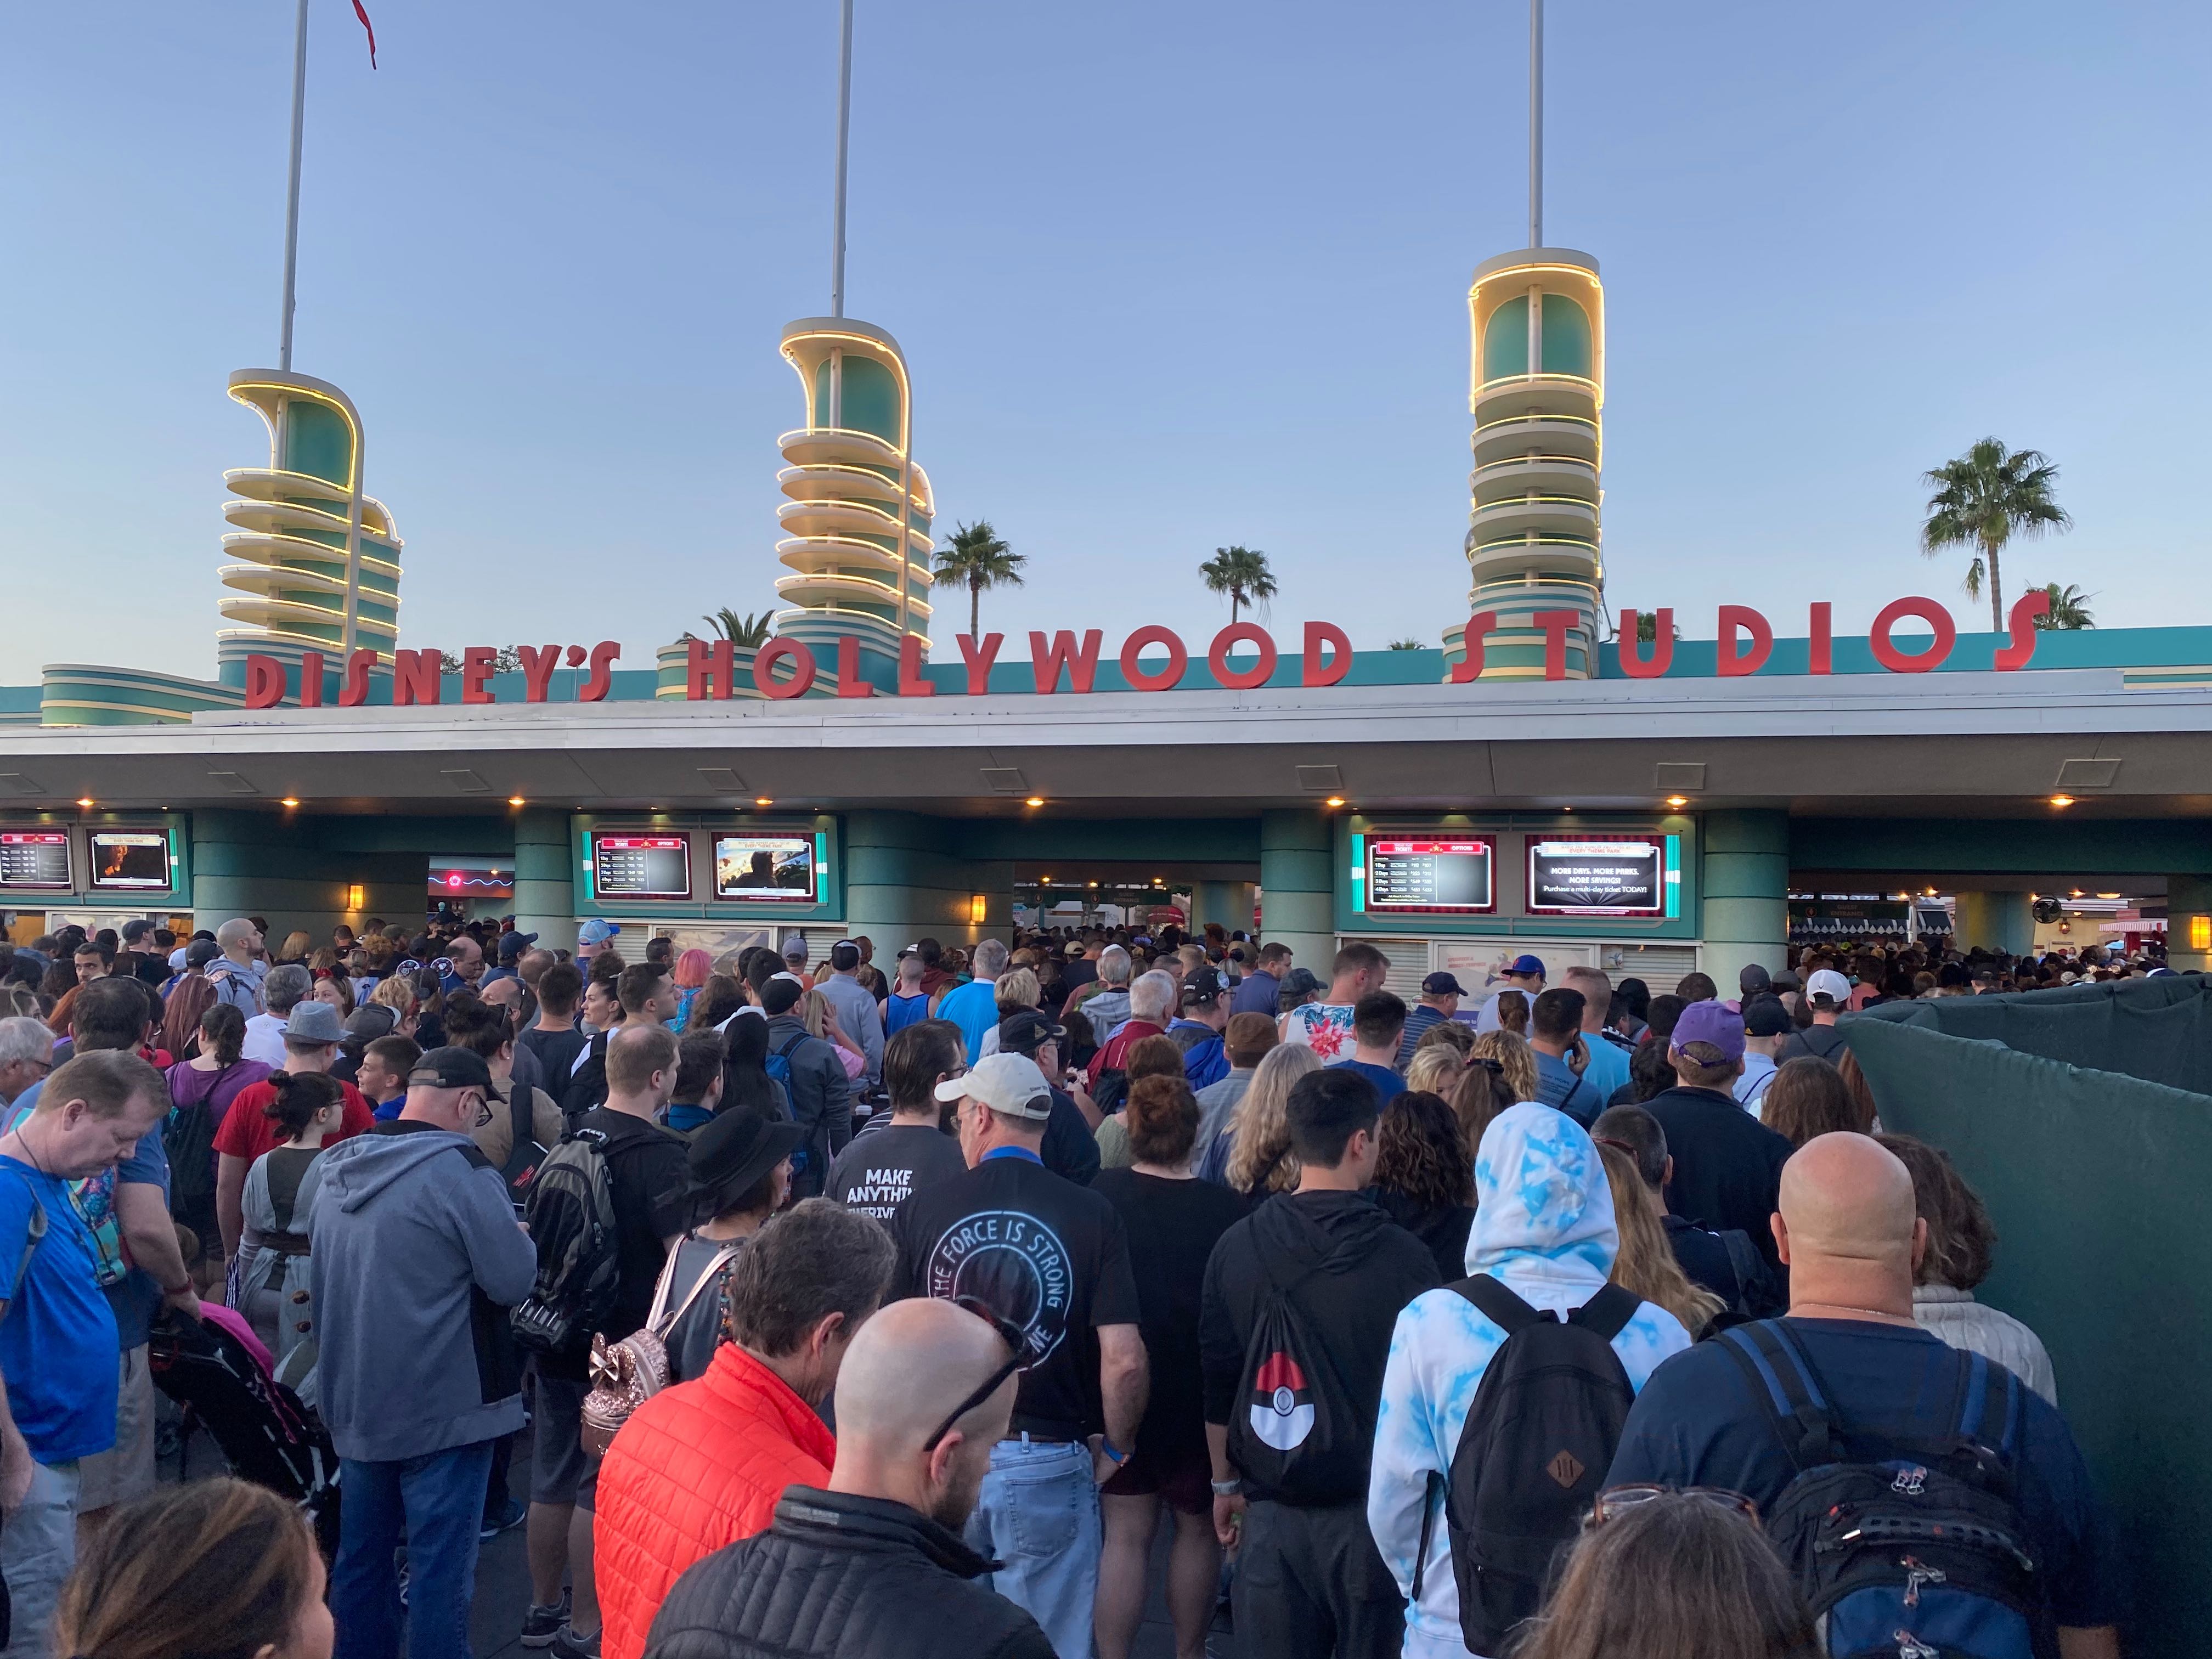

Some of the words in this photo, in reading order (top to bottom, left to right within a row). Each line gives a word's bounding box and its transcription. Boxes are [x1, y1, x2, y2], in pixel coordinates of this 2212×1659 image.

[245, 641, 620, 710] DISNEY'S
[687, 622, 1353, 700] HOLLYWOOD
[1450, 591, 2050, 684] STUDIOS
[1576, 885, 1604, 894] multi-day
[866, 1169, 913, 1185] MAKE
[847, 1186, 915, 1204] ANYTHI
[942, 1220, 997, 1264] FORCE
[1006, 1220, 1025, 1242] IS
[1027, 1234, 1065, 1308] STRONG
